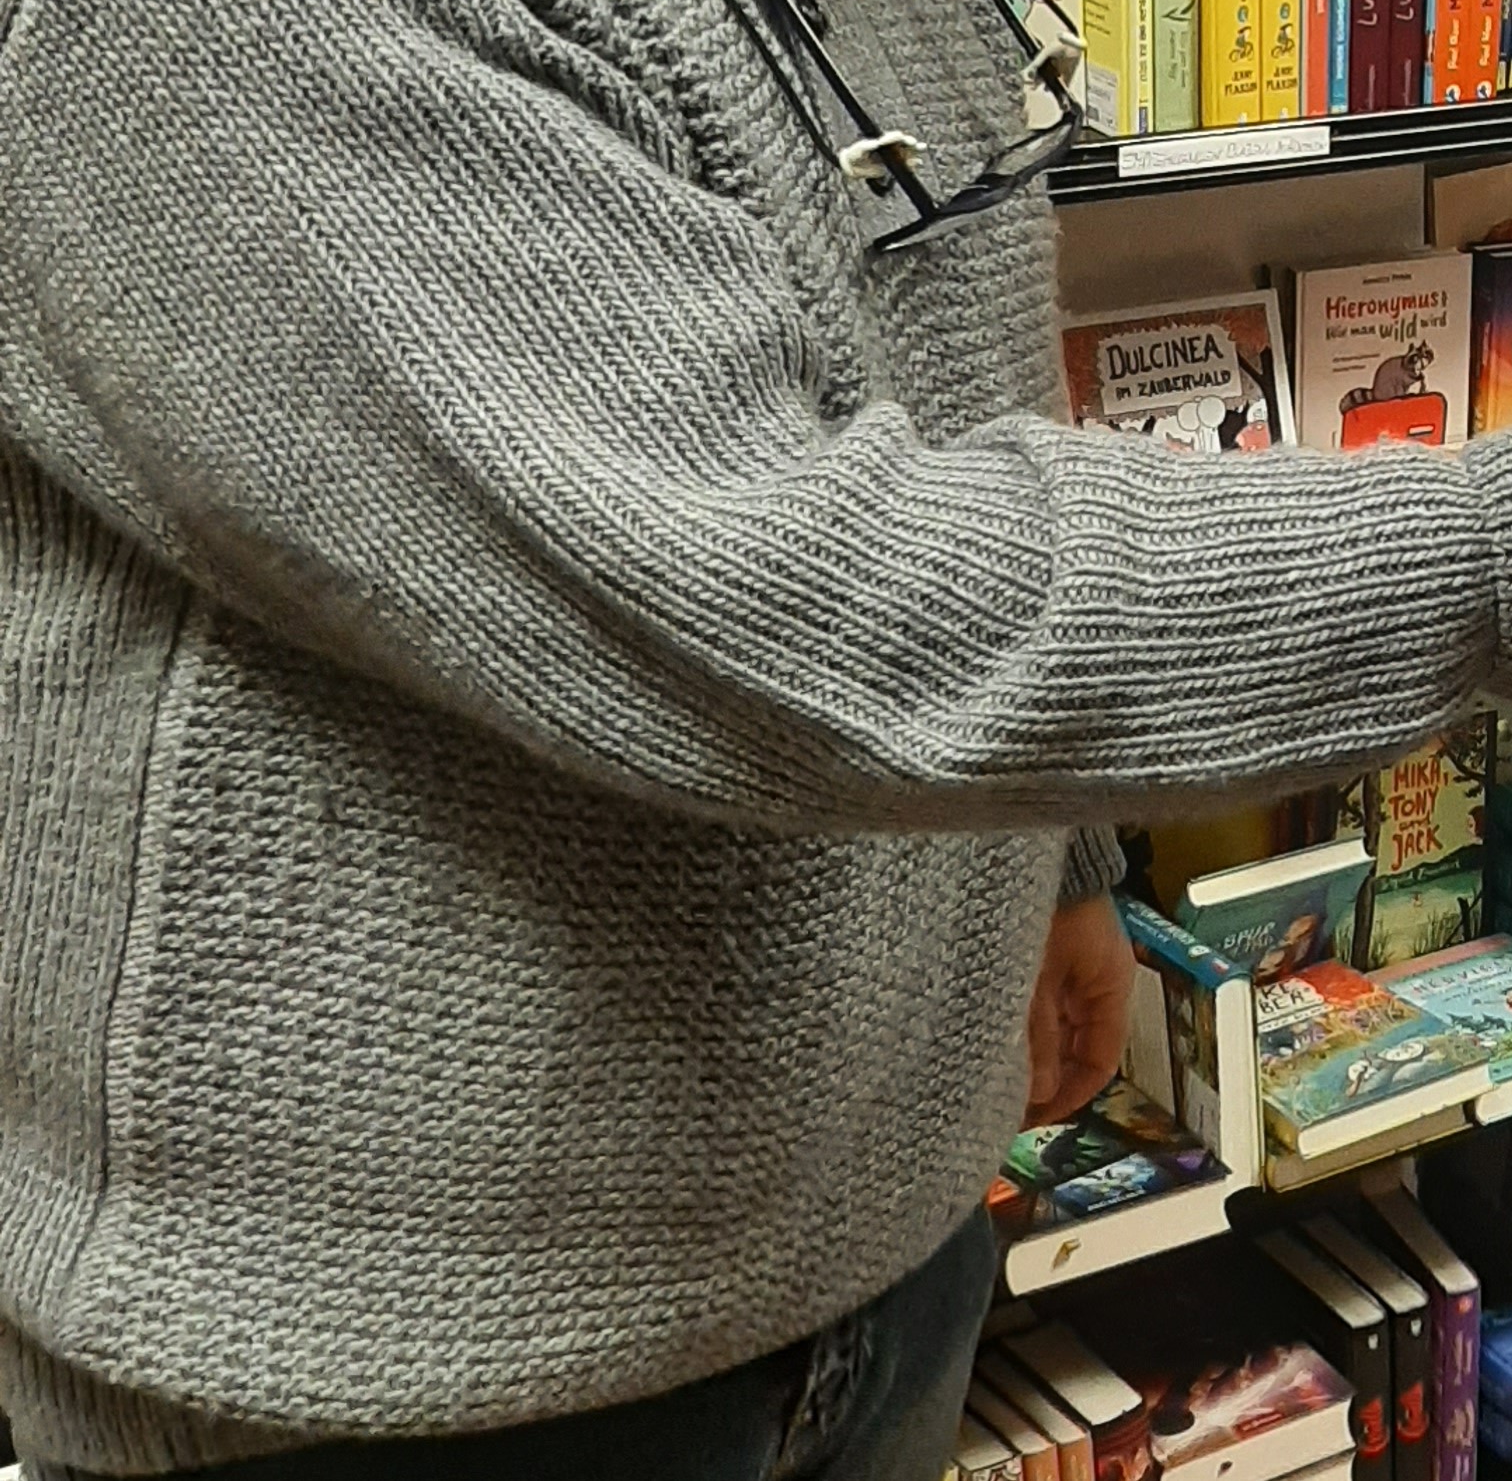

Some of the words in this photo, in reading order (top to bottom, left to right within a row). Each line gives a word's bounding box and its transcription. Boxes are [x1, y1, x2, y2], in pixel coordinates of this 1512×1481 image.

[1350, 324, 1376, 336] man
[1379, 312, 1418, 343] wild
[1106, 333, 1223, 380] DULCINEA
[1138, 370, 1232, 398] ZAUBERWALD
[1388, 788, 1440, 820] TONY
[1391, 826, 1444, 871] JACK
